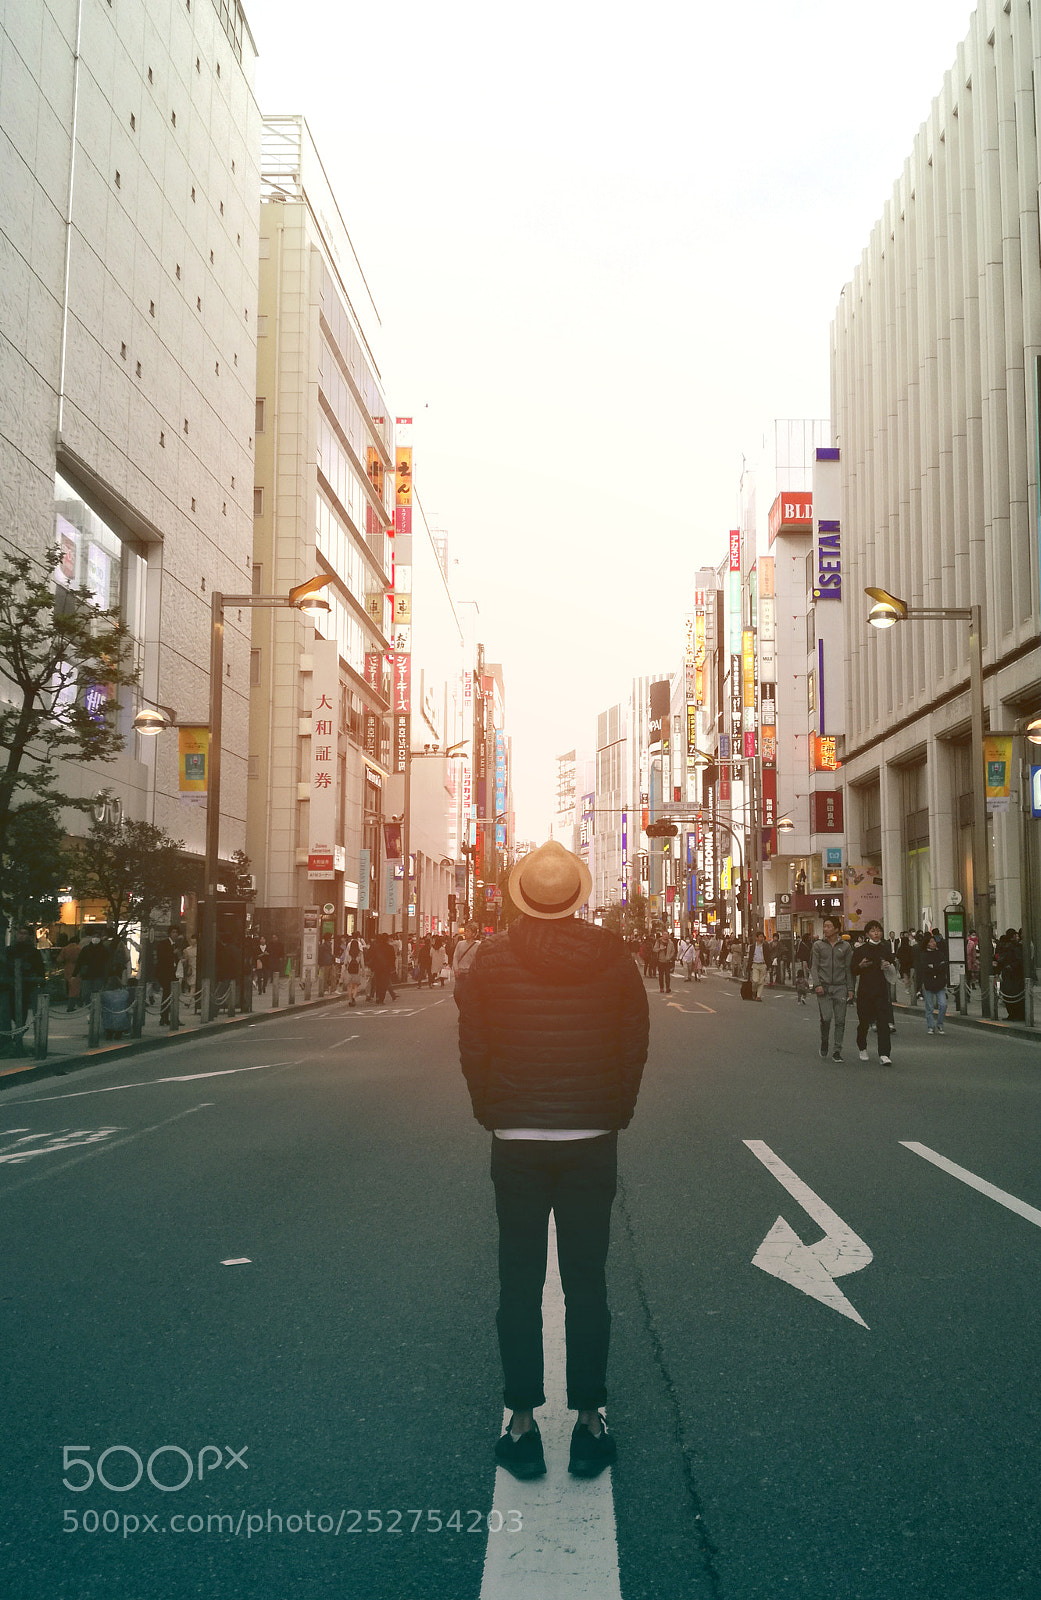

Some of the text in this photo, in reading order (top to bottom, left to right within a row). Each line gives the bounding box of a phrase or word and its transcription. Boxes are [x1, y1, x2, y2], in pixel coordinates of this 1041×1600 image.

[731, 535, 739, 567] アカネビル
[812, 520, 841, 600] ISETAN
[396, 655, 409, 711] シェーキーズ
[314, 694, 333, 789] 大和証券
[826, 797, 835, 827] 無印良品
[705, 831, 714, 901] CALZEDONIA
